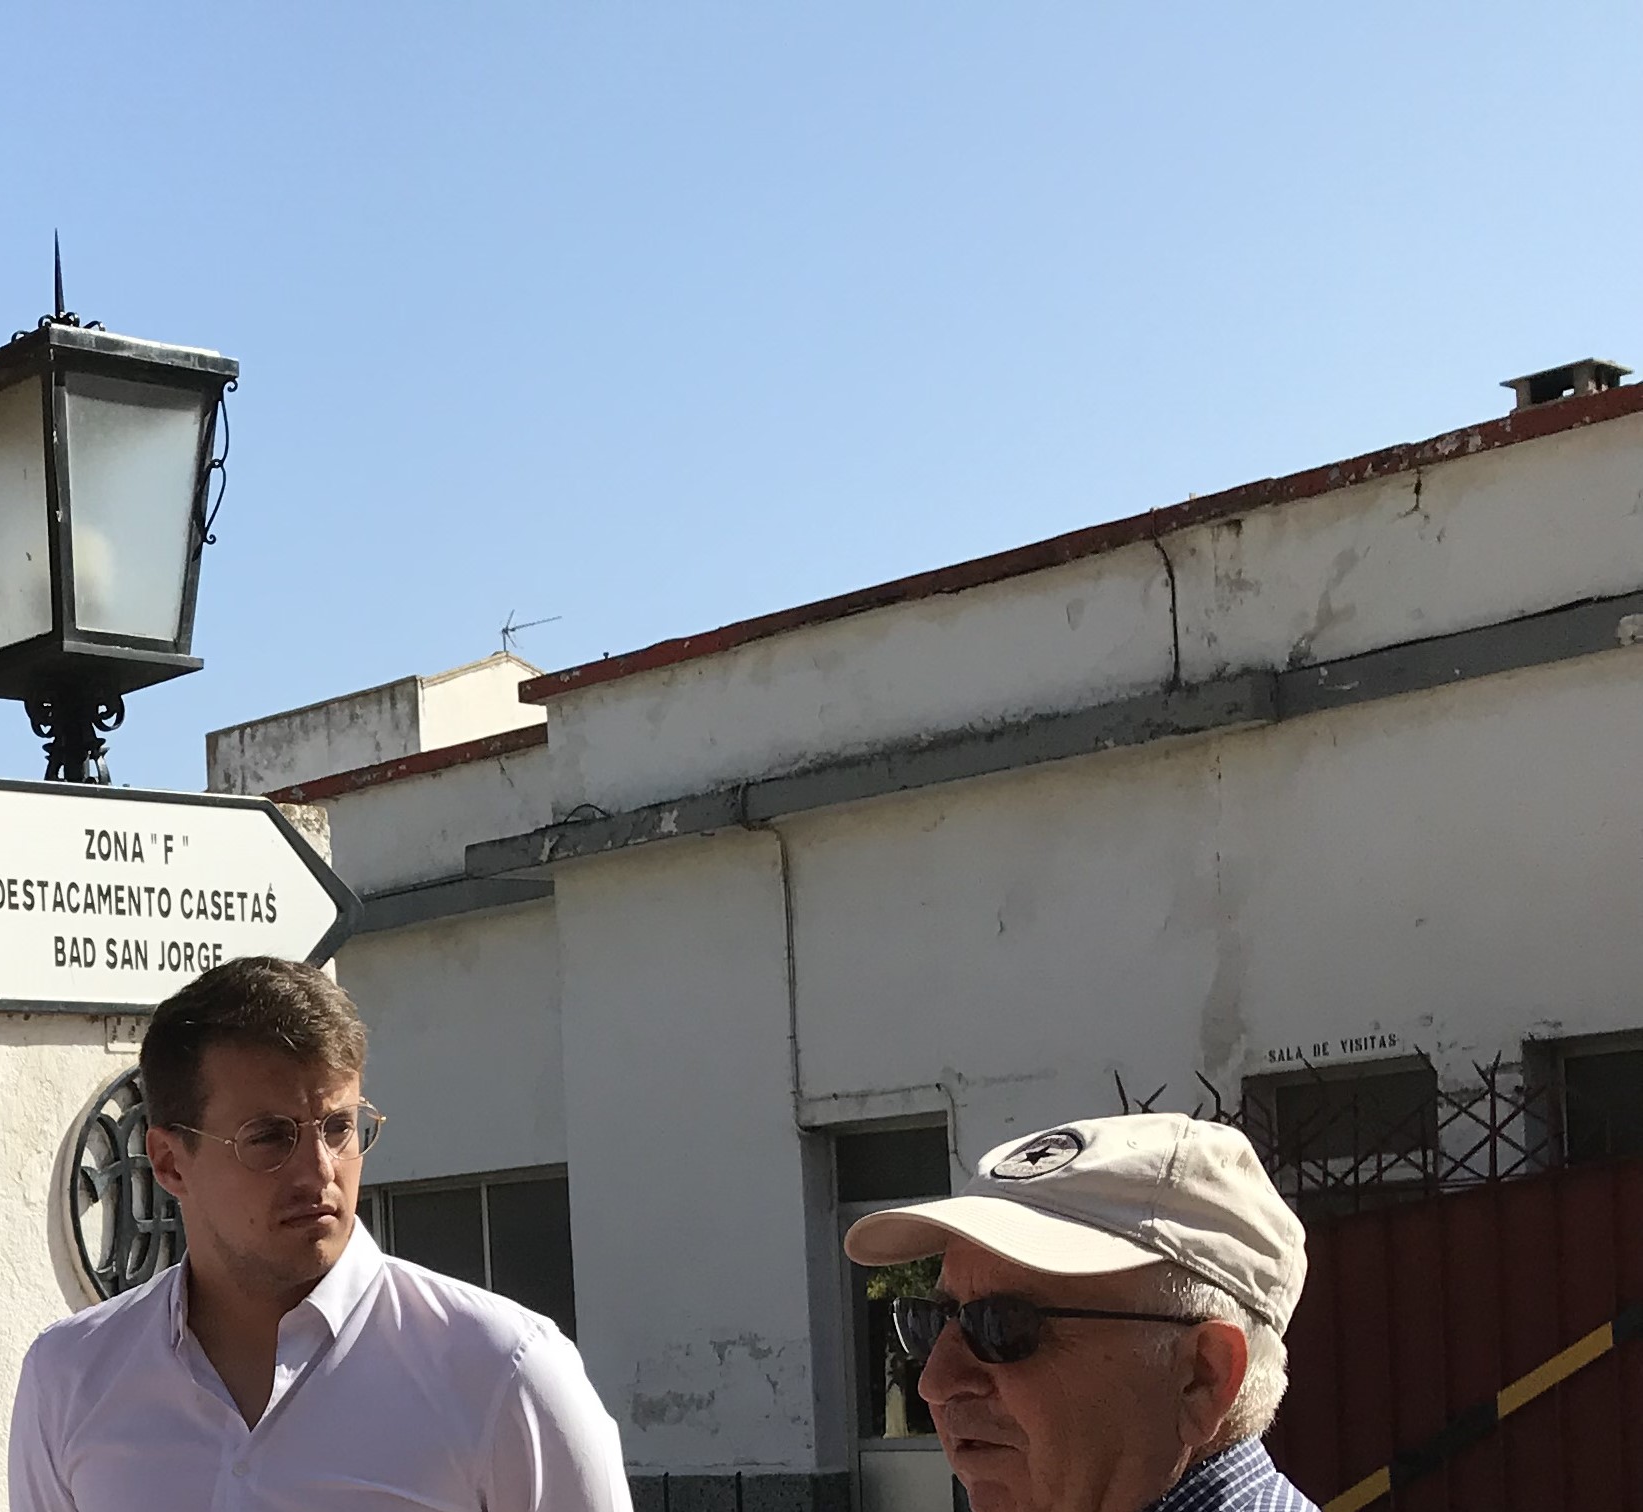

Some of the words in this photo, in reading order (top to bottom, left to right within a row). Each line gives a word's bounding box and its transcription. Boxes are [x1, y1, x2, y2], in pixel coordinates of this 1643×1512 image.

[85, 829, 144, 863] ZONA
[54, 936, 96, 968] BAD
[106, 938, 148, 970] SAN
[158, 940, 223, 973] JORGE
[1268, 1046, 1305, 1063] SALA
[1313, 1041, 1330, 1057] DE
[1340, 1033, 1397, 1054] VISITAS
